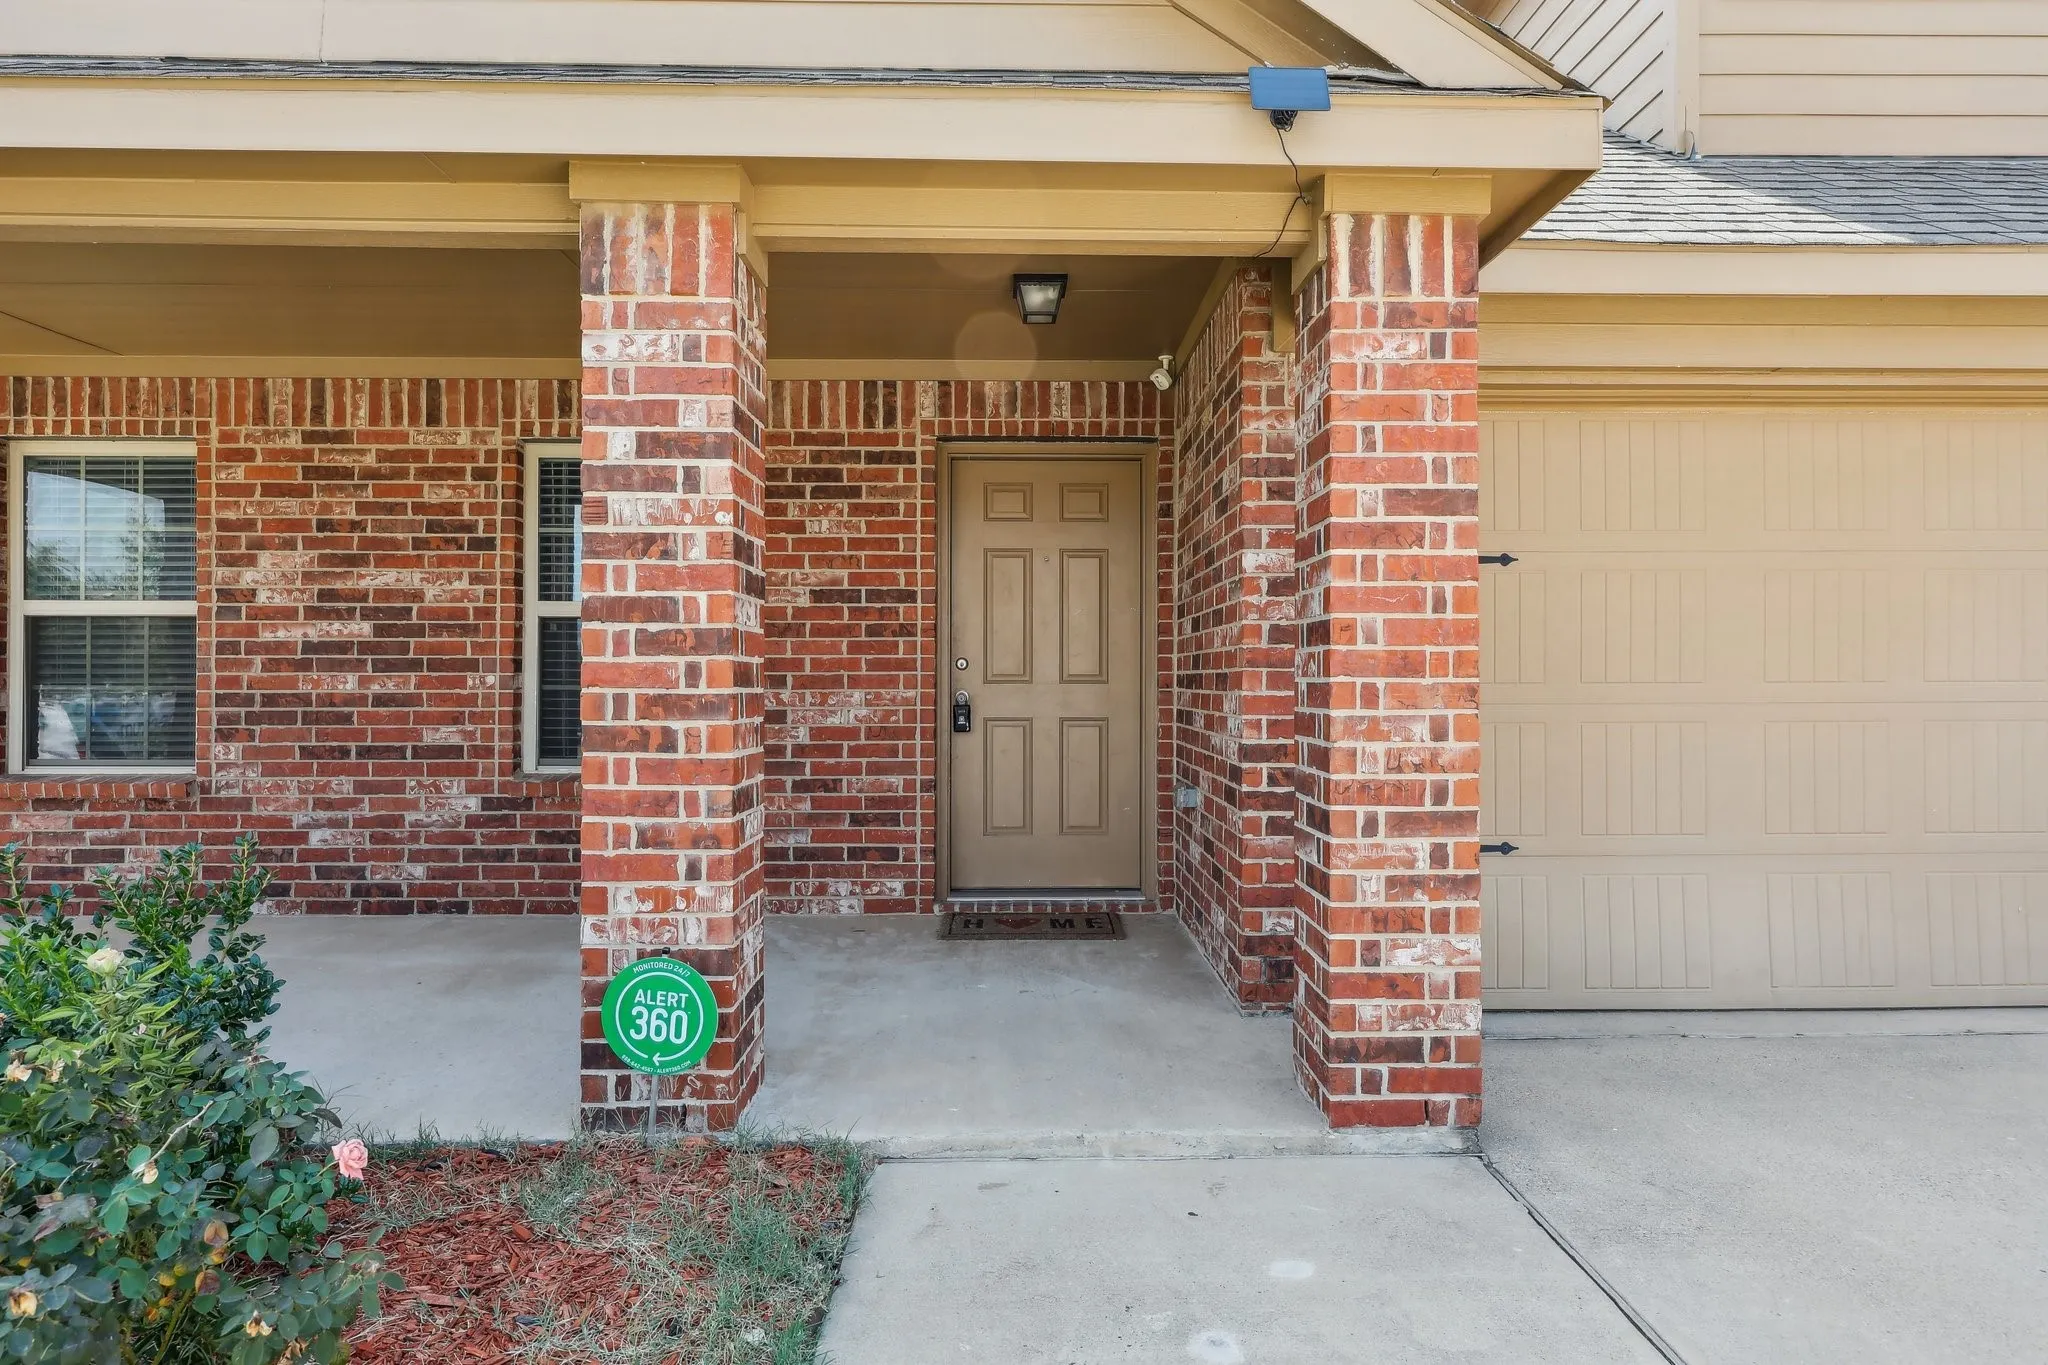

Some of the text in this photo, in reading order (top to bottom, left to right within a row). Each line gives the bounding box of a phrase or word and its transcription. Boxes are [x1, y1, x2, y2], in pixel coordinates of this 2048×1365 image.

[633, 962, 691, 977] MONITORED 24/7
[634, 989, 689, 1008] ALERT
[630, 1006, 688, 1044] 360
[656, 1060, 692, 1074] ALERT360.COM
